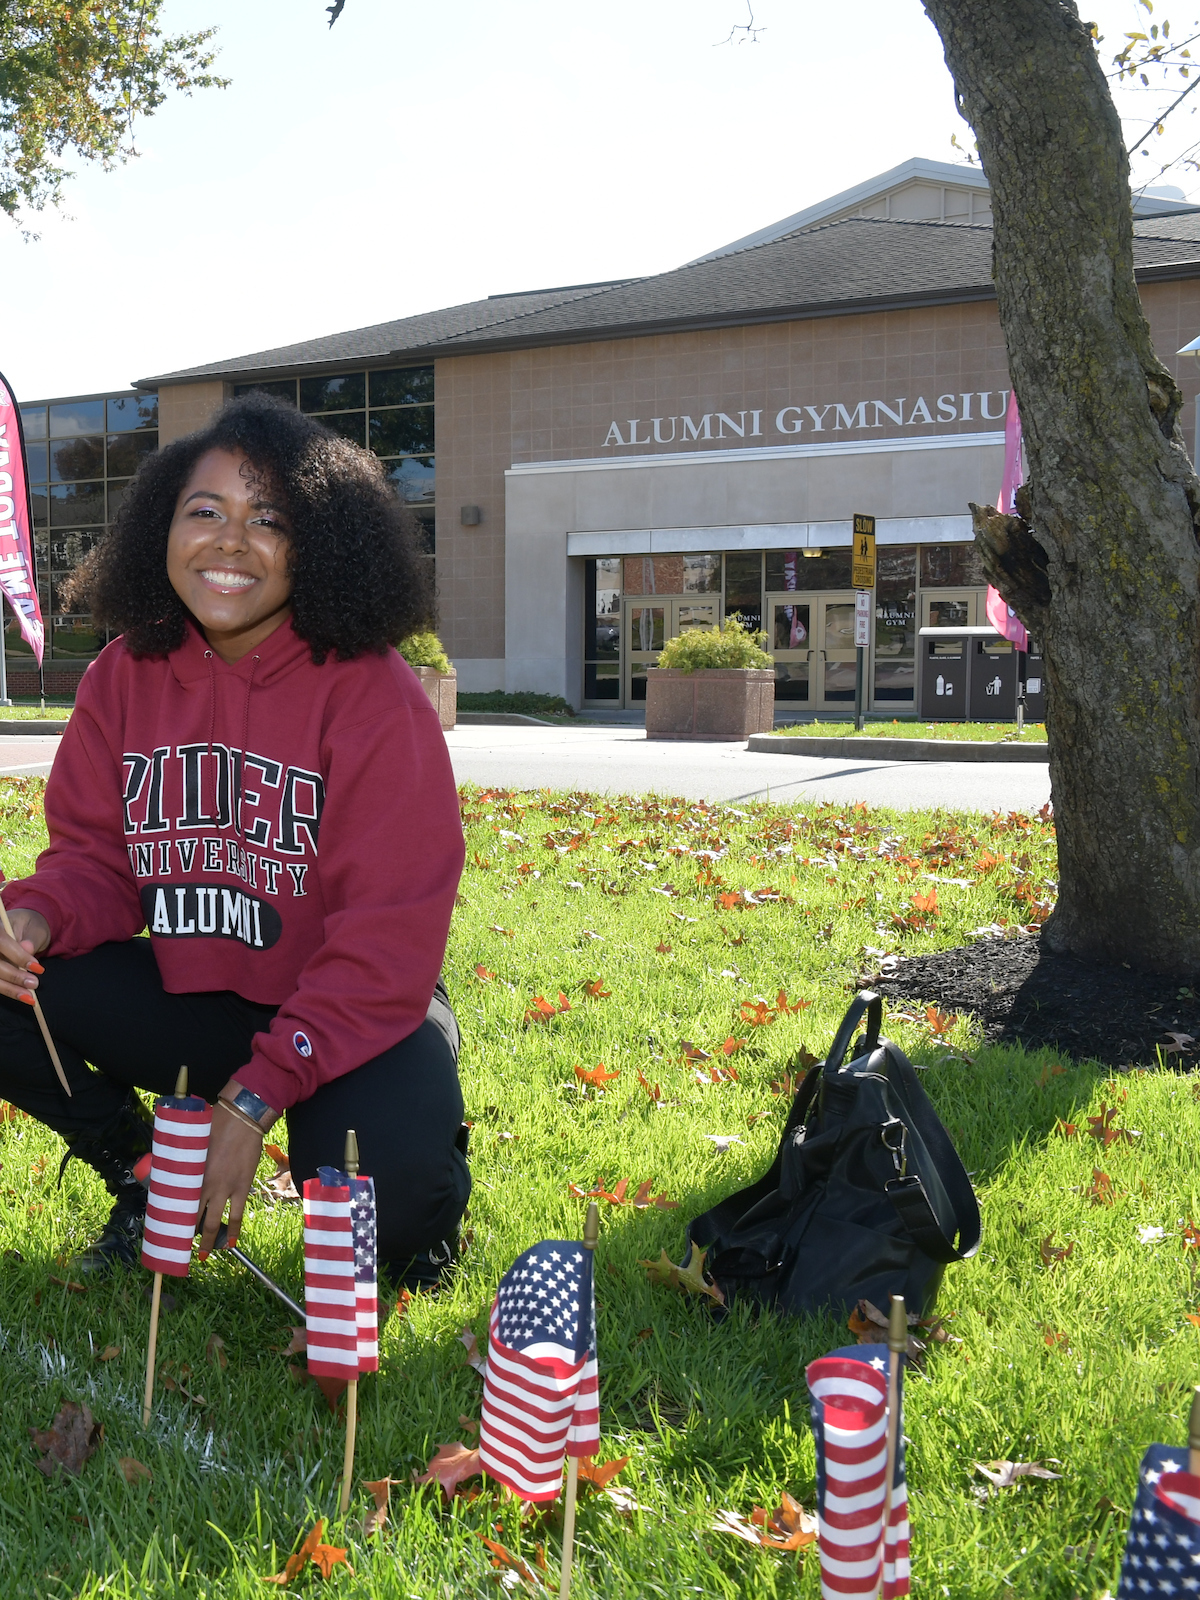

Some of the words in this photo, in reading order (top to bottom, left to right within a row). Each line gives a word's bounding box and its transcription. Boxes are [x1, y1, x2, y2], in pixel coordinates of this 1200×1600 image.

[601, 409, 763, 447] ALUMNI
[776, 390, 1010, 435] GYMNASIU
[855, 518, 873, 533] SLOW
[152, 887, 264, 947] ALUMNI
